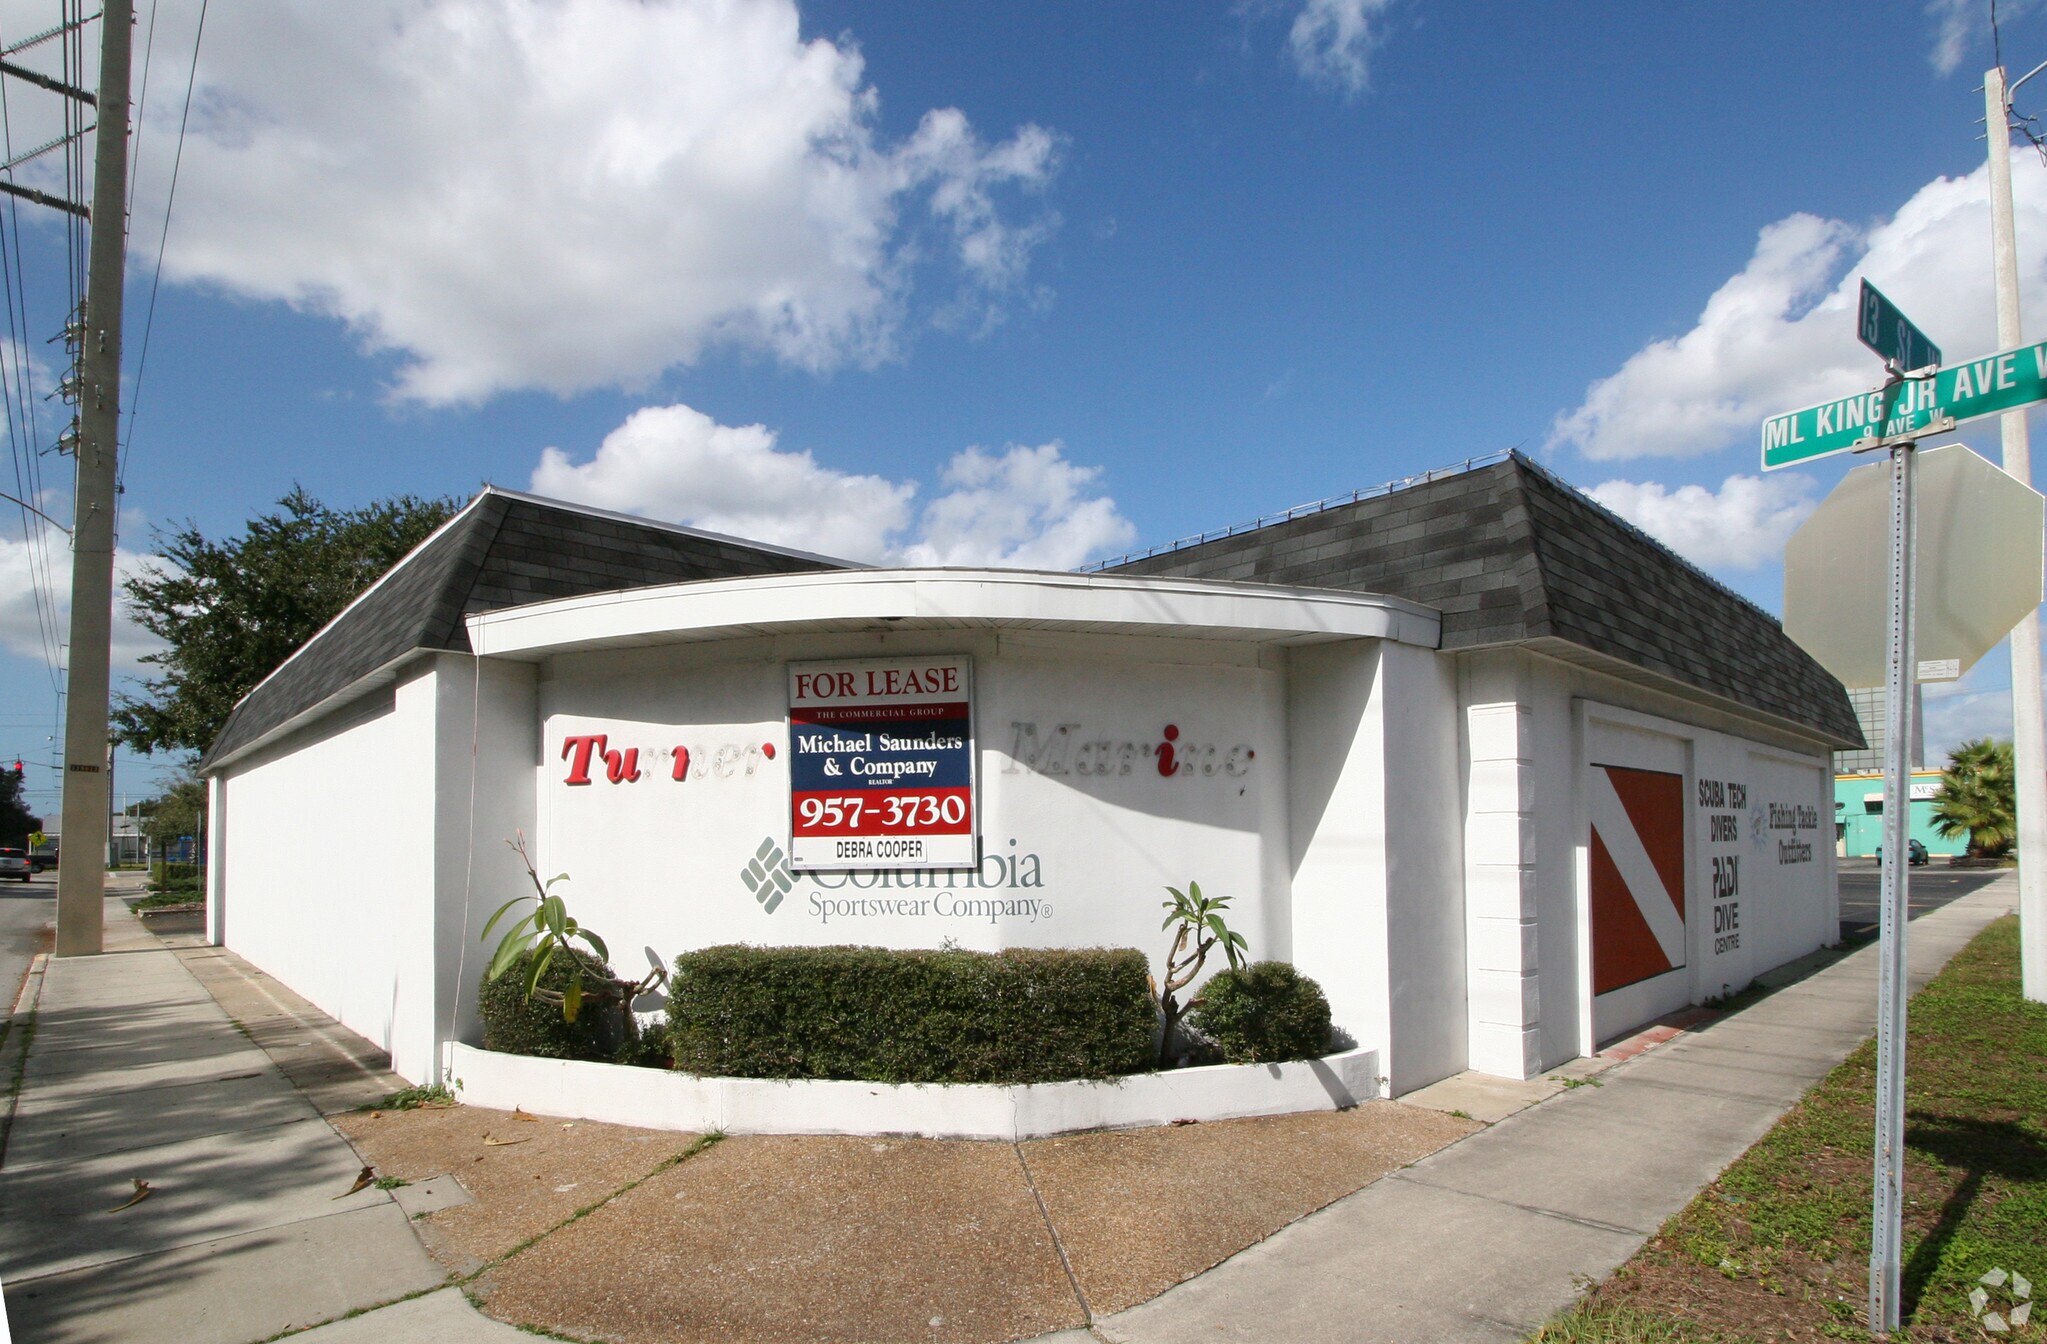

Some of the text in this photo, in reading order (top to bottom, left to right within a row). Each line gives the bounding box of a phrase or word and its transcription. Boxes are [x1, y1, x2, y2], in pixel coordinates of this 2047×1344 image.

[1861, 288, 1879, 345] 13
[1766, 415, 1804, 450] ML
[1817, 392, 1884, 438] KING
[1898, 379, 1936, 415] JR
[1952, 353, 2016, 402] AVE
[1886, 414, 1915, 437] AVE
[795, 667, 959, 699] FOR LEASE
[816, 707, 945, 719] THE COMMERCIAL GROUP
[798, 730, 963, 754] Michael Saunders
[823, 756, 938, 779] & Company
[1698, 778, 1747, 809] SCUBA TECH
[799, 795, 967, 829] 957-3730
[1711, 814, 1738, 843] DIVERS
[836, 839, 923, 859] DEBRA COOPER
[809, 891, 930, 924] Sportswear
[1713, 902, 1739, 934] DIVE
[1714, 933, 1740, 955] CENTRE
